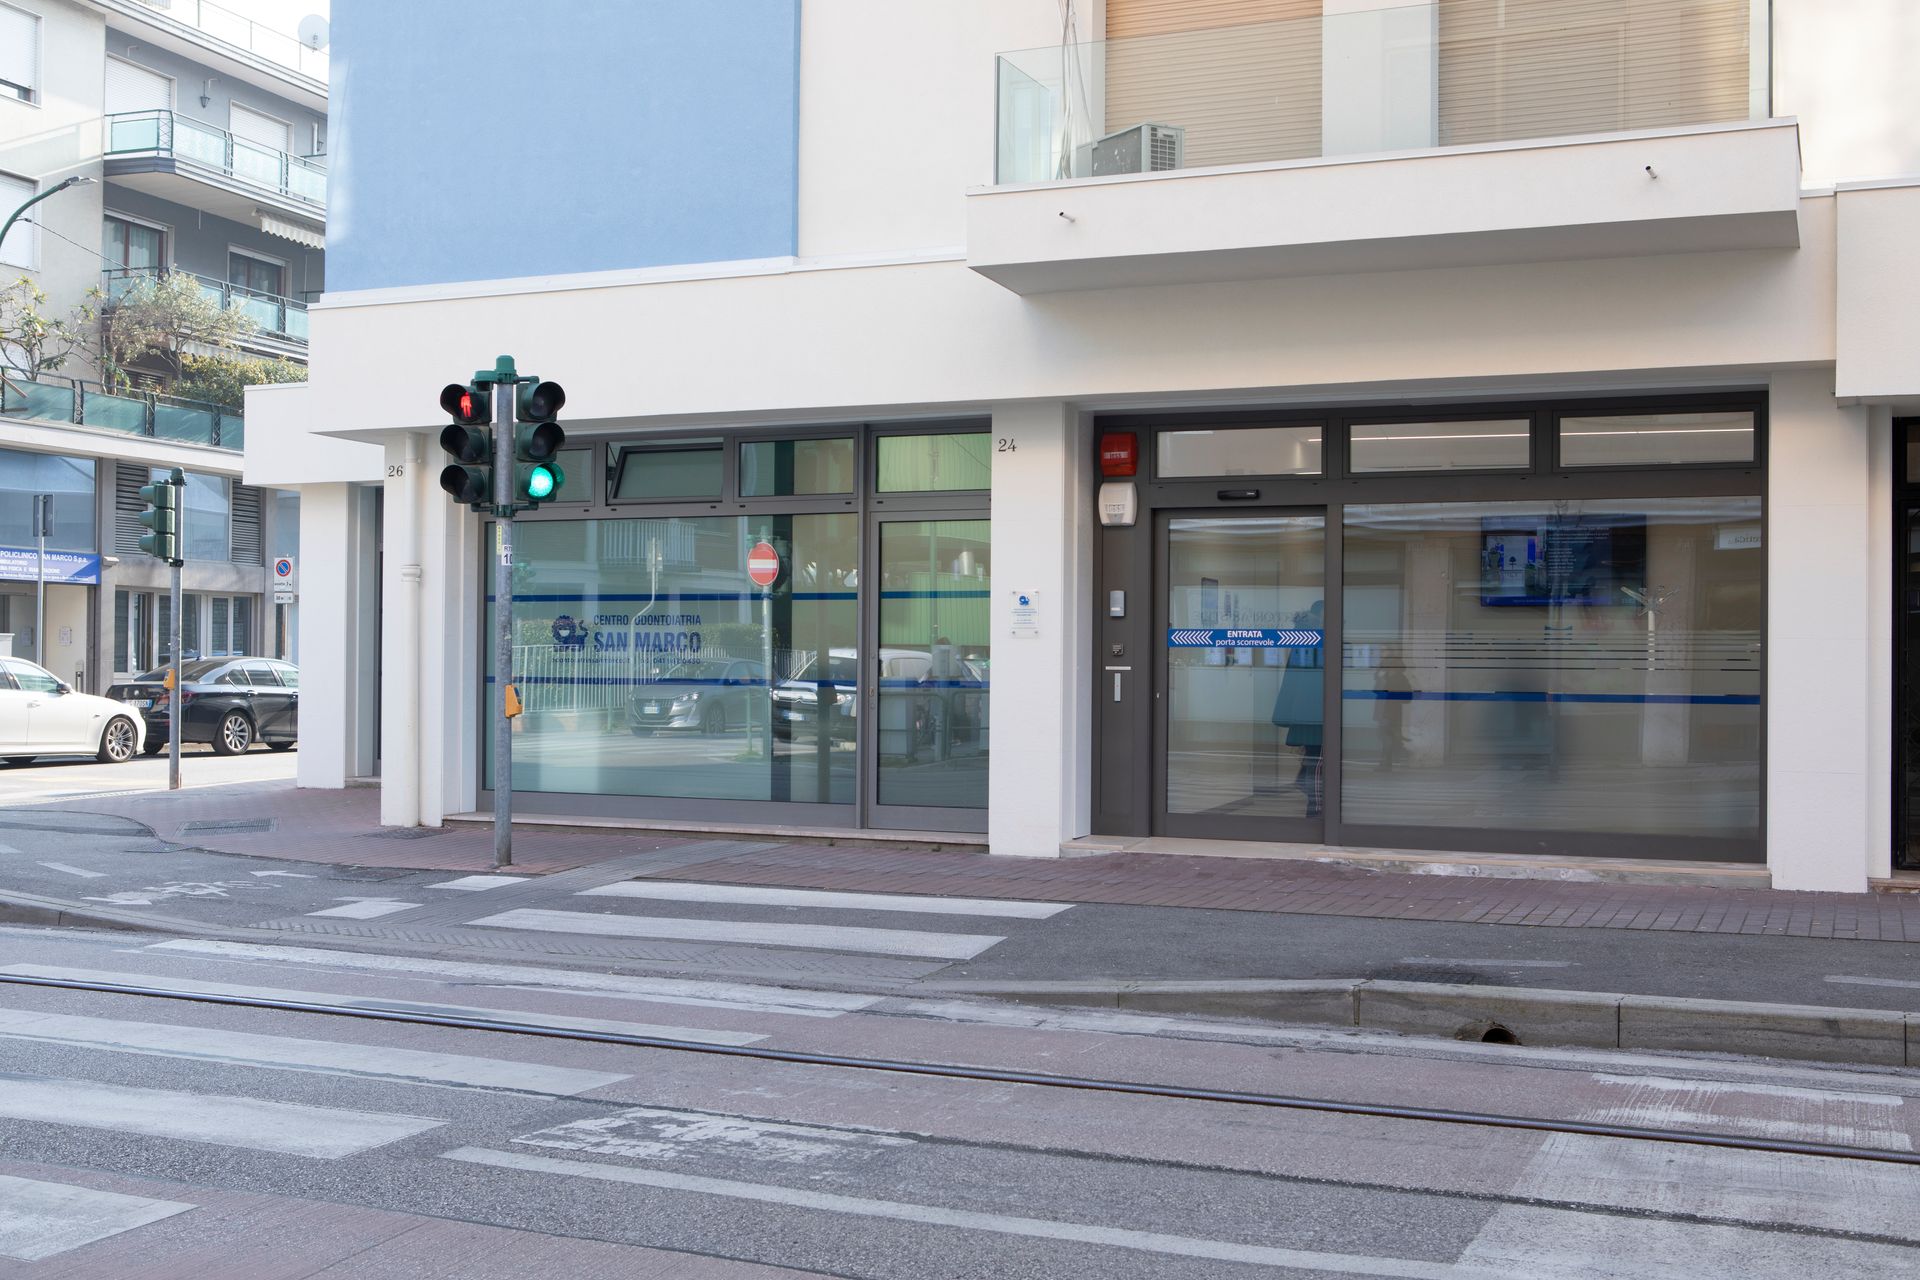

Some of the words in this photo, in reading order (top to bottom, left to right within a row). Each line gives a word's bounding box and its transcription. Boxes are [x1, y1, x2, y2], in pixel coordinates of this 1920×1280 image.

[998, 438, 1016, 452] 24
[388, 465, 403, 477] 26
[0, 551, 37, 559] POLICLINICO
[594, 615, 629, 626] CENTRO
[635, 615, 701, 626] ODONTOIATRIA
[1227, 630, 1262, 638] ENTRATA
[594, 632, 628, 652] SAN
[635, 632, 701, 652] MARCO
[1215, 639, 1235, 647] porta
[1237, 638, 1274, 646] scorrevole
